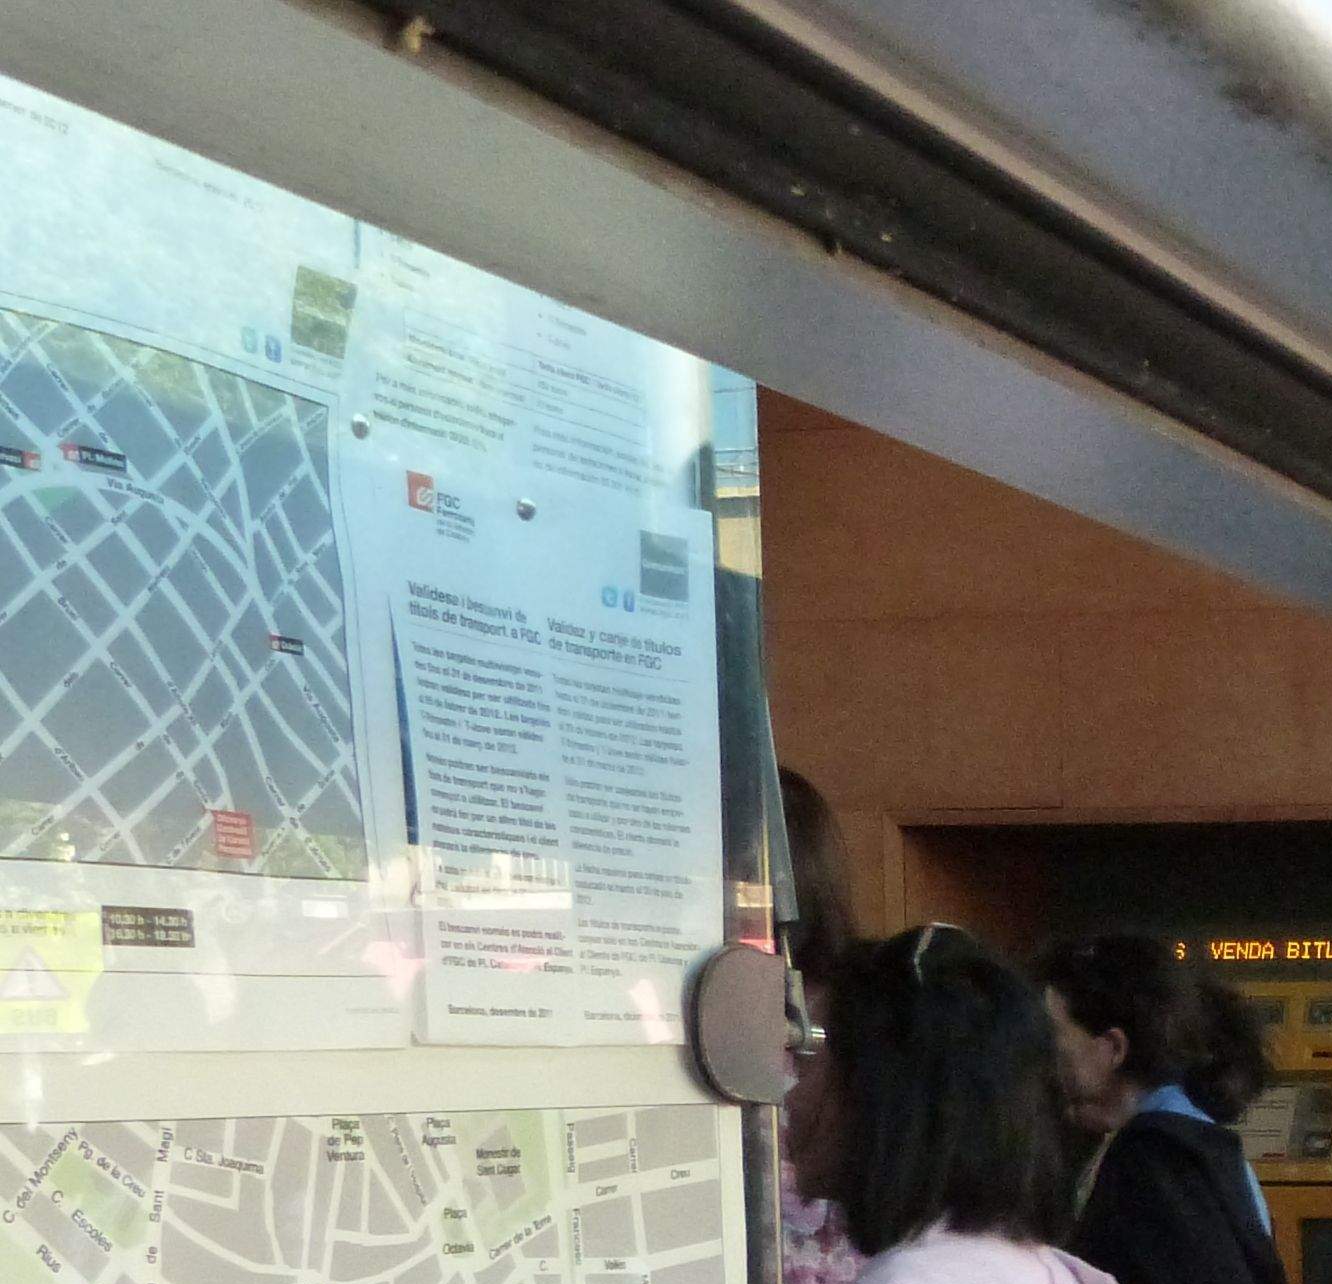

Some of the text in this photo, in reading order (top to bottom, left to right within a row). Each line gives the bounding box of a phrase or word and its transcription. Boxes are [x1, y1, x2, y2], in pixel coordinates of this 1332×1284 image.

[437, 493, 460, 509] FGC
[442, 610, 458, 624] de
[549, 638, 563, 650] de
[638, 654, 662, 670] FGC
[1211, 941, 1275, 960] VENDA
[149, 1190, 164, 1223] Sant
[71, 1209, 113, 1253] Escoles
[147, 1245, 157, 1265] de
